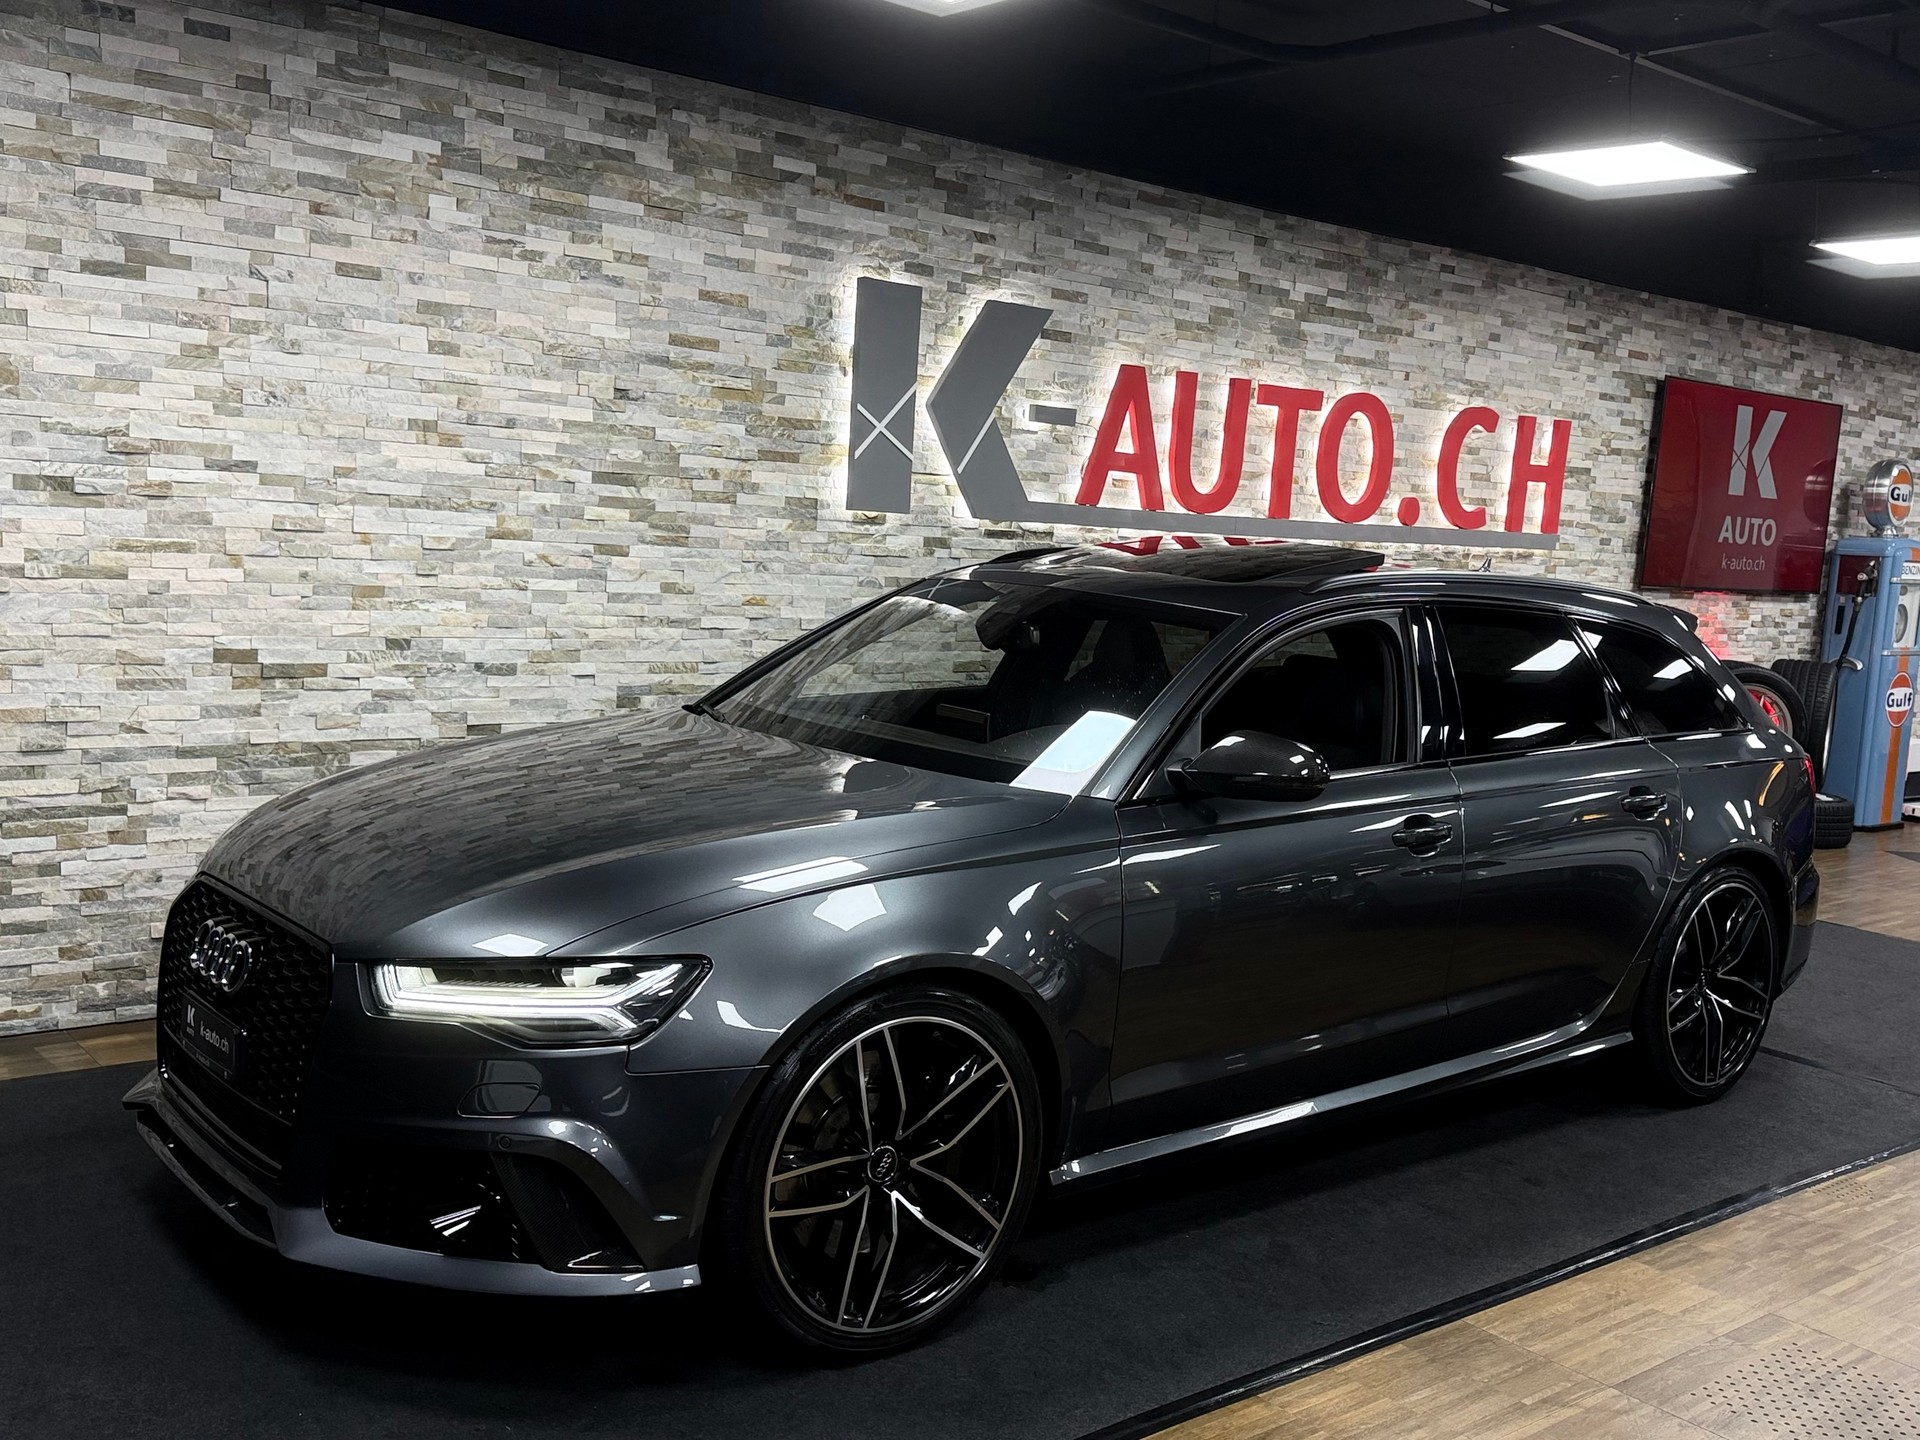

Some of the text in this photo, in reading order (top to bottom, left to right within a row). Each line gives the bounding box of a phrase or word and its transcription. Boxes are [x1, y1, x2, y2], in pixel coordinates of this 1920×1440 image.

[1728, 404, 1787, 499] K
[1718, 515, 1776, 546] AUTO
[1721, 553, 1765, 571] k-auto.ch
[1886, 691, 1912, 708] Gulf
[200, 1020, 230, 1055] k-auto.ch
